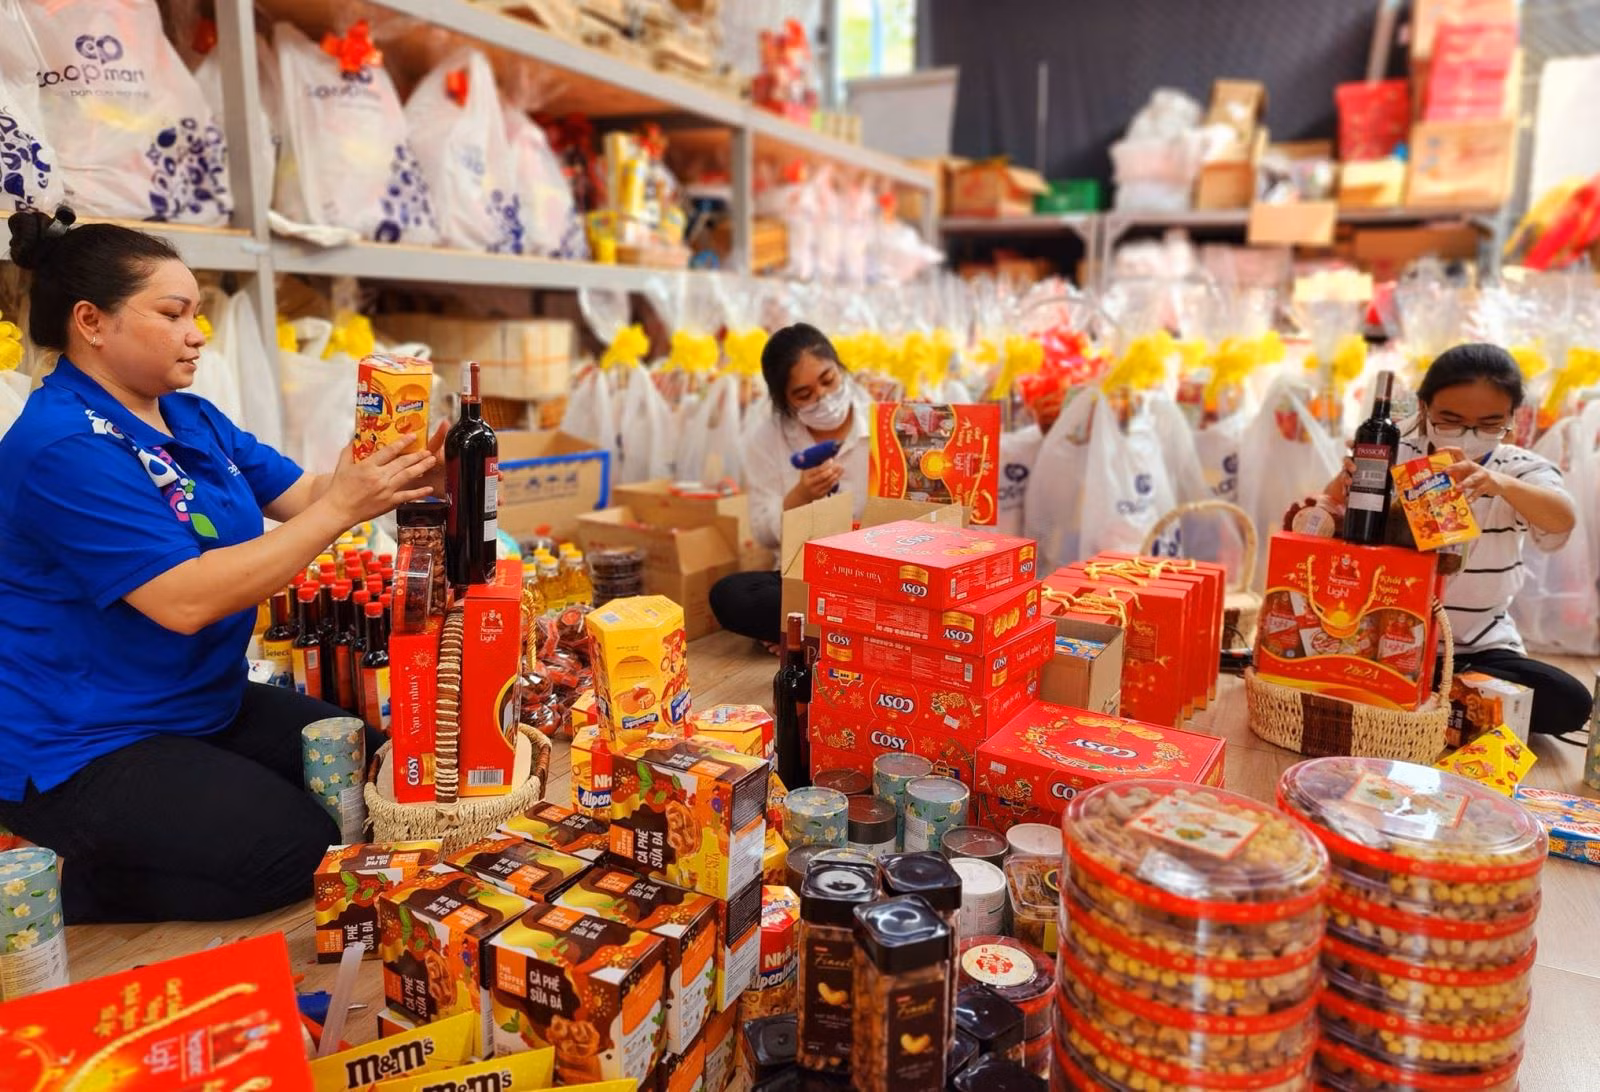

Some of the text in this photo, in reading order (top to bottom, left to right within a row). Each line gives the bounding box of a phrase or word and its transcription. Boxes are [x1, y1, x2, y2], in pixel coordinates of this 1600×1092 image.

[1357, 447, 1387, 457] PASSION
[900, 583, 928, 597] COSY
[1327, 585, 1349, 599] Light
[480, 634, 497, 643] Light
[827, 632, 851, 646] COSY
[943, 628, 973, 644] COSY
[877, 693, 914, 714] COSY
[870, 730, 908, 751] COSY
[1067, 738, 1138, 759] COSY
[407, 757, 420, 786] COSY
[594, 774, 612, 788] Nh
[581, 790, 611, 808] Alpen
[1051, 783, 1082, 801] CO
[635, 828, 649, 864] CÀ PHÊ
[650, 831, 663, 846] ĐÁ
[529, 969, 560, 992] CÀ PHÊ
[550, 995, 563, 1010] ĐÁ
[346, 1038, 435, 1089] m&m's
